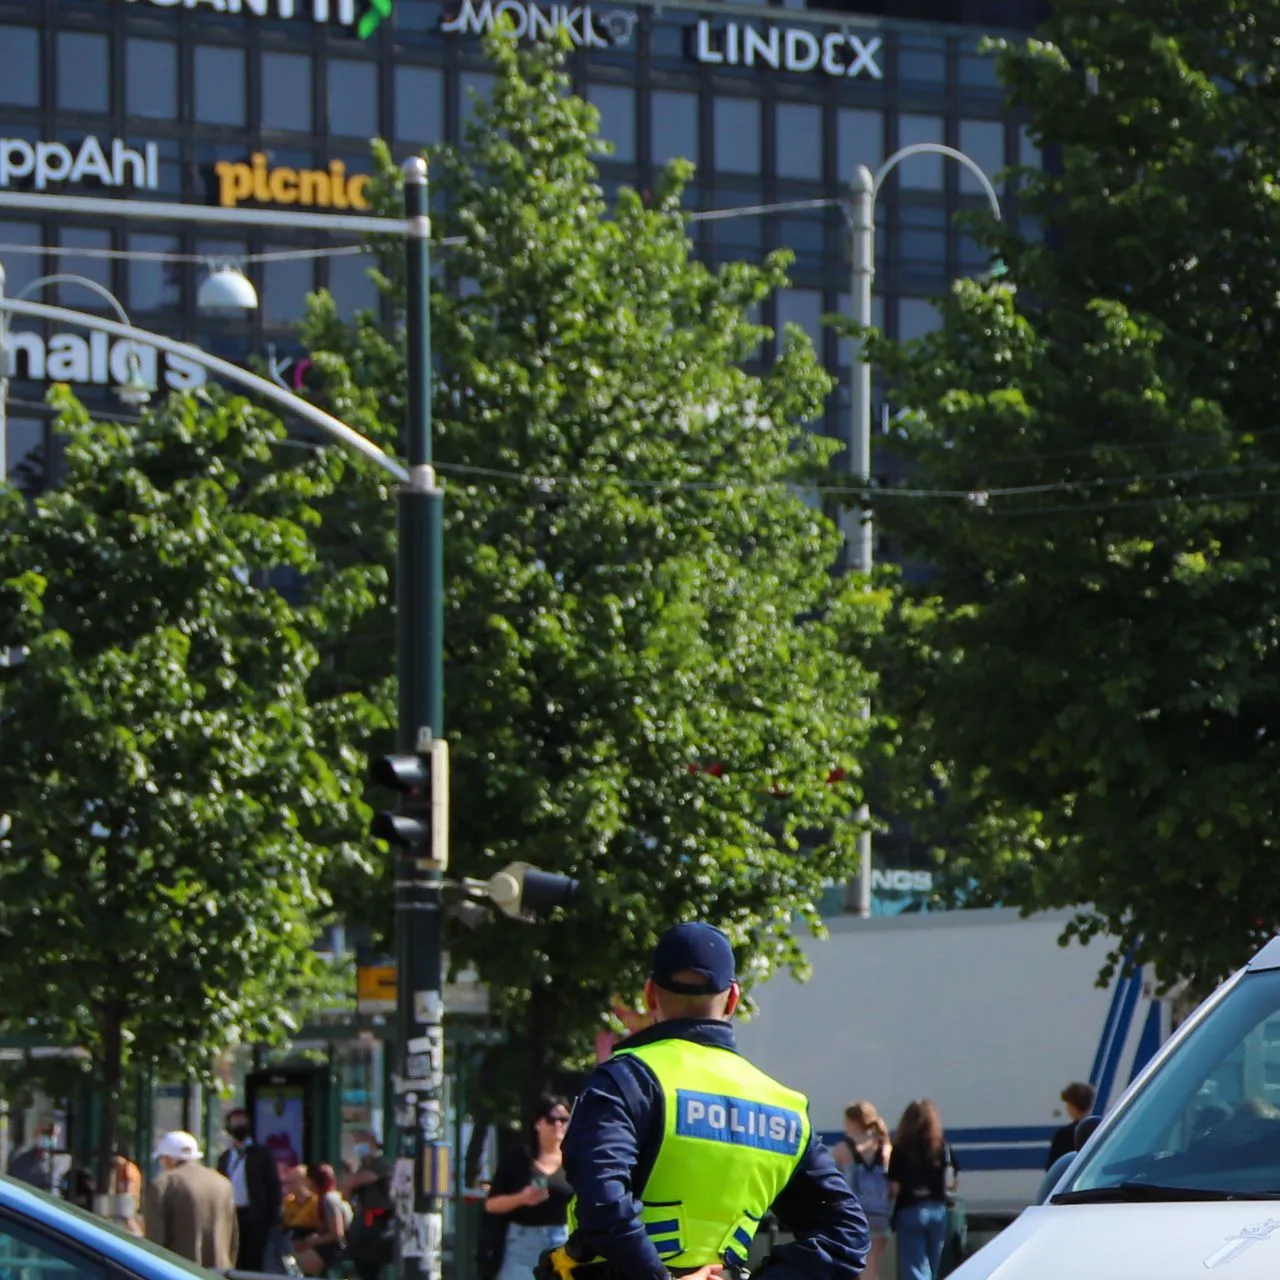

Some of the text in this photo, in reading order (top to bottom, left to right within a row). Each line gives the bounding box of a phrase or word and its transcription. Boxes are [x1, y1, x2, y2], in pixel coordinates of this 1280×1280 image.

[699, 19, 883, 79] LINDEX
[0, 136, 158, 190] ppAhl
[215, 151, 373, 209] picnic
[686, 1099, 799, 1142] POLIISI
